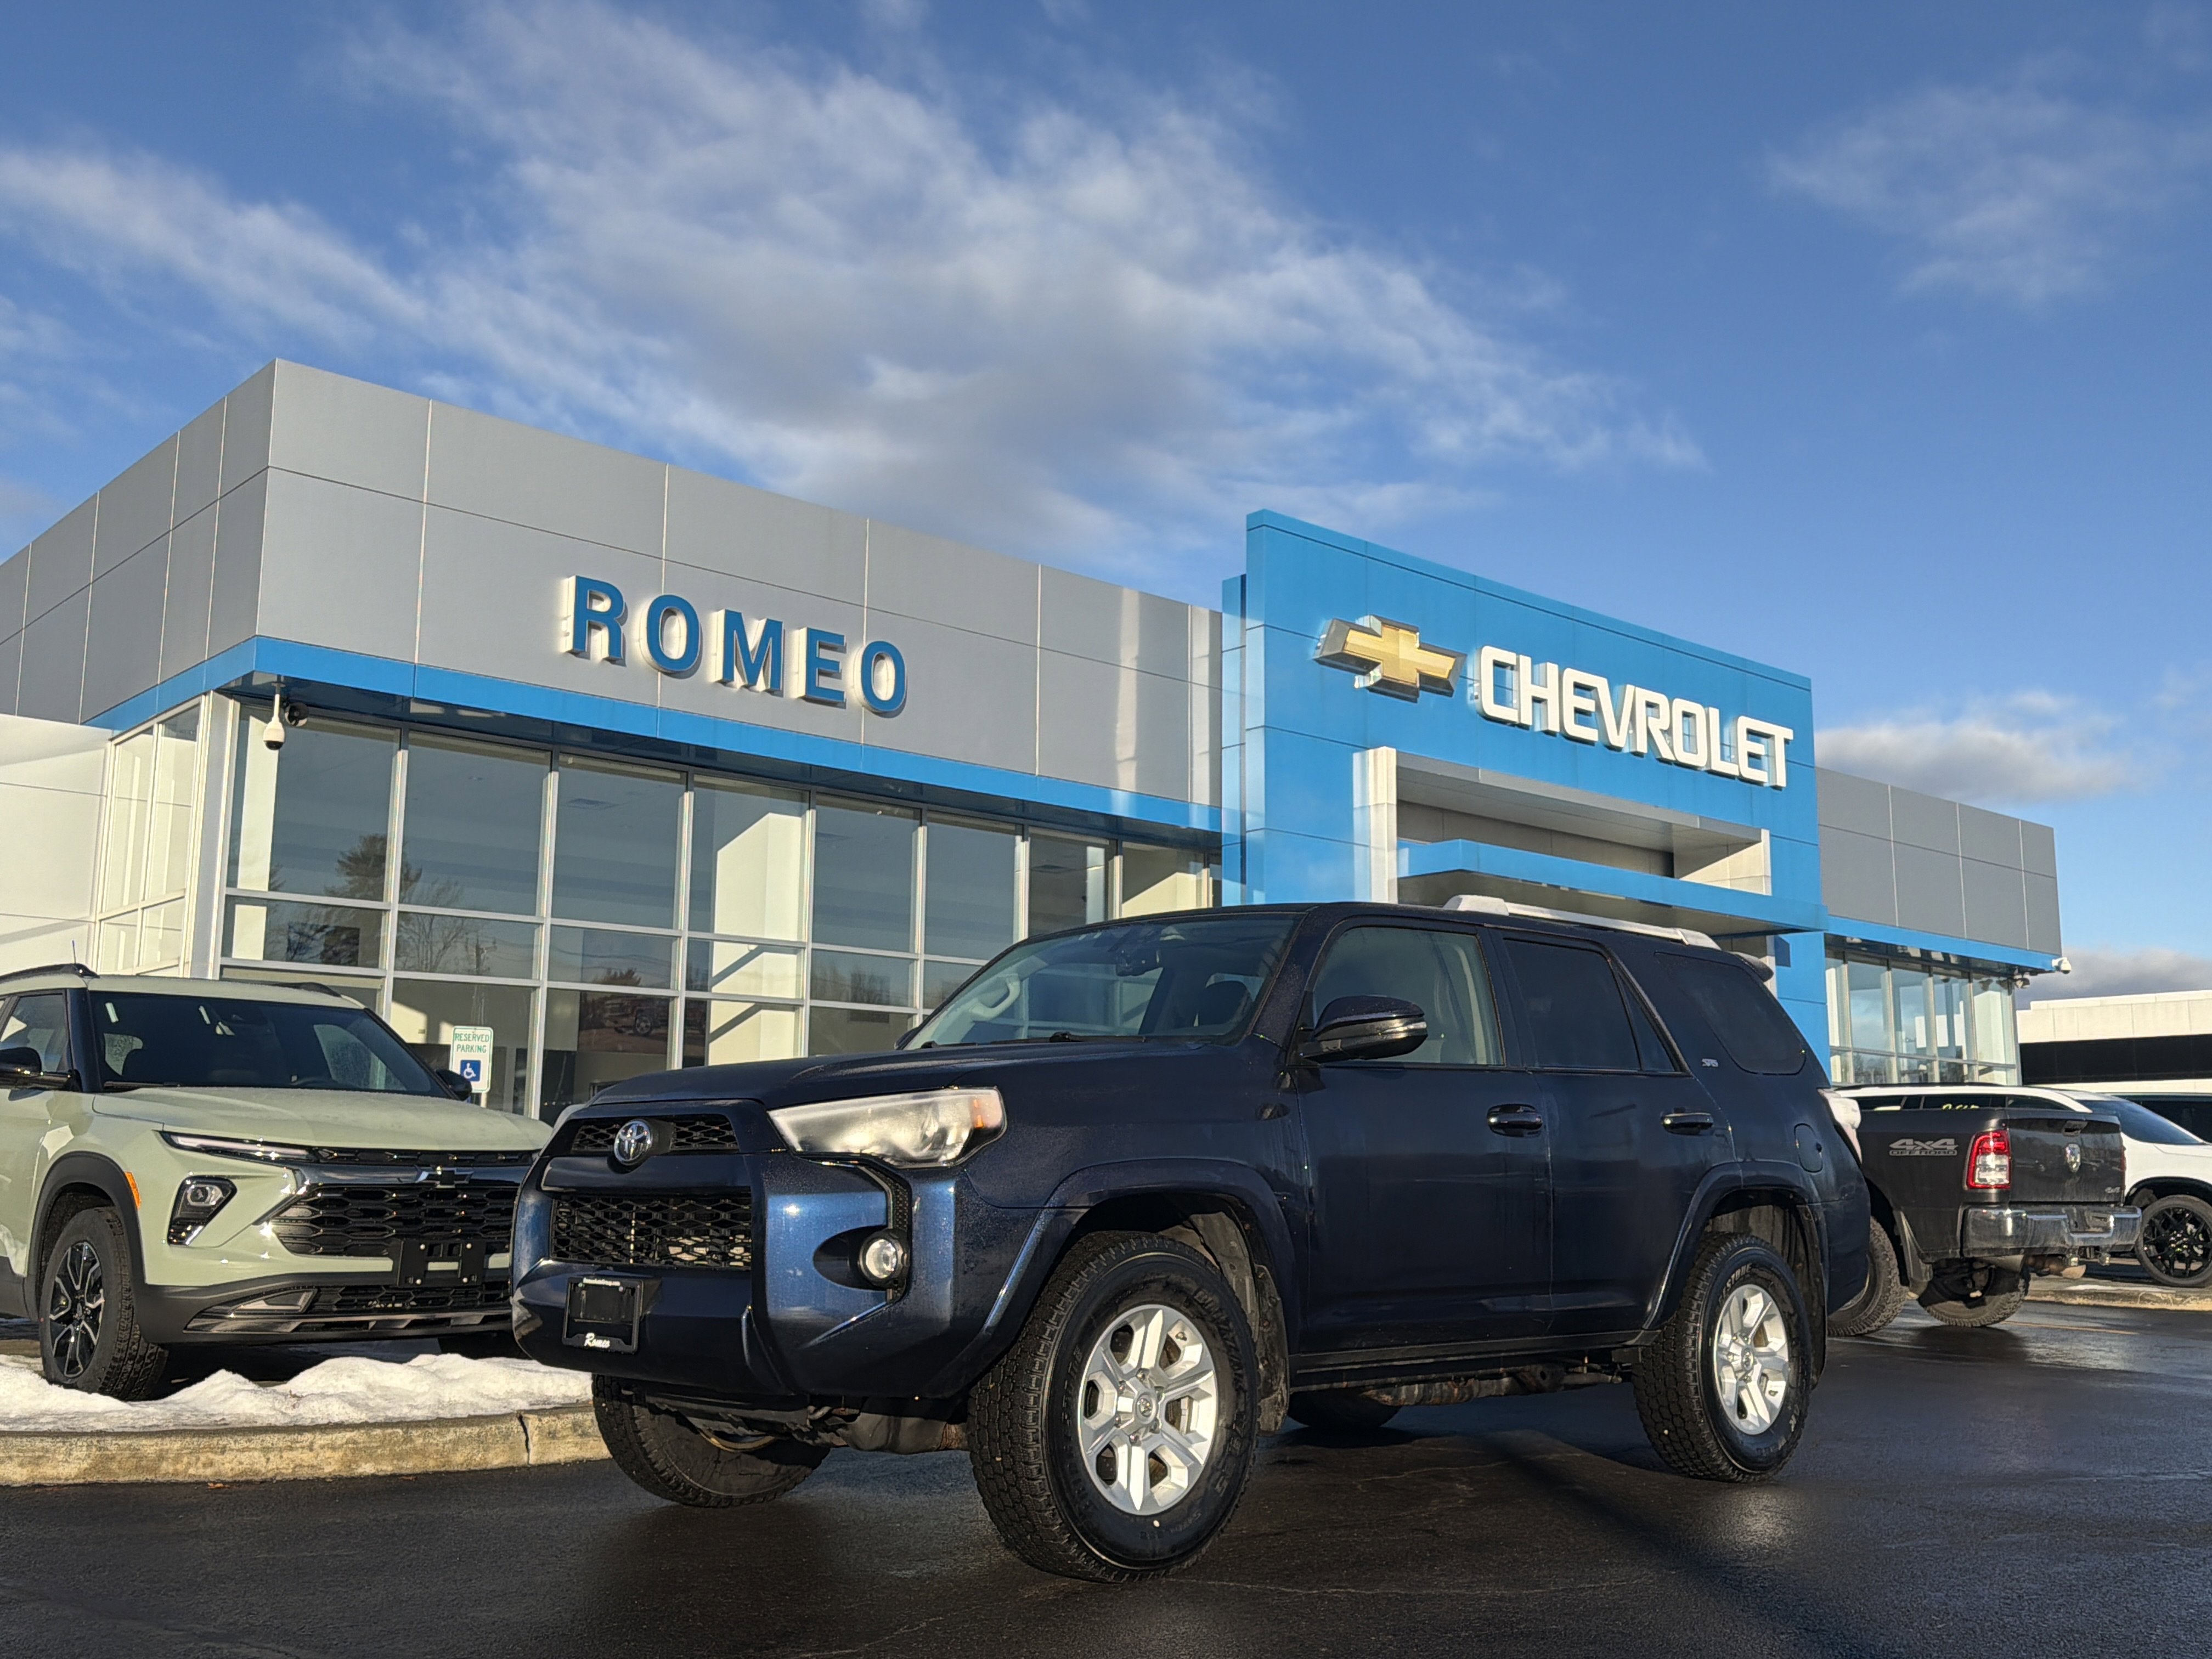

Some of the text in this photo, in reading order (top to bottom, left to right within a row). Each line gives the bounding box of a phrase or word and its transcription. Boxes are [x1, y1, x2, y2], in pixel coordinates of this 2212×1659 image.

[567, 574, 907, 714] ROMEO
[1476, 645, 1793, 790] CHEVROLET
[455, 1032, 489, 1042] RESERVED
[456, 1044, 487, 1053] PARKING
